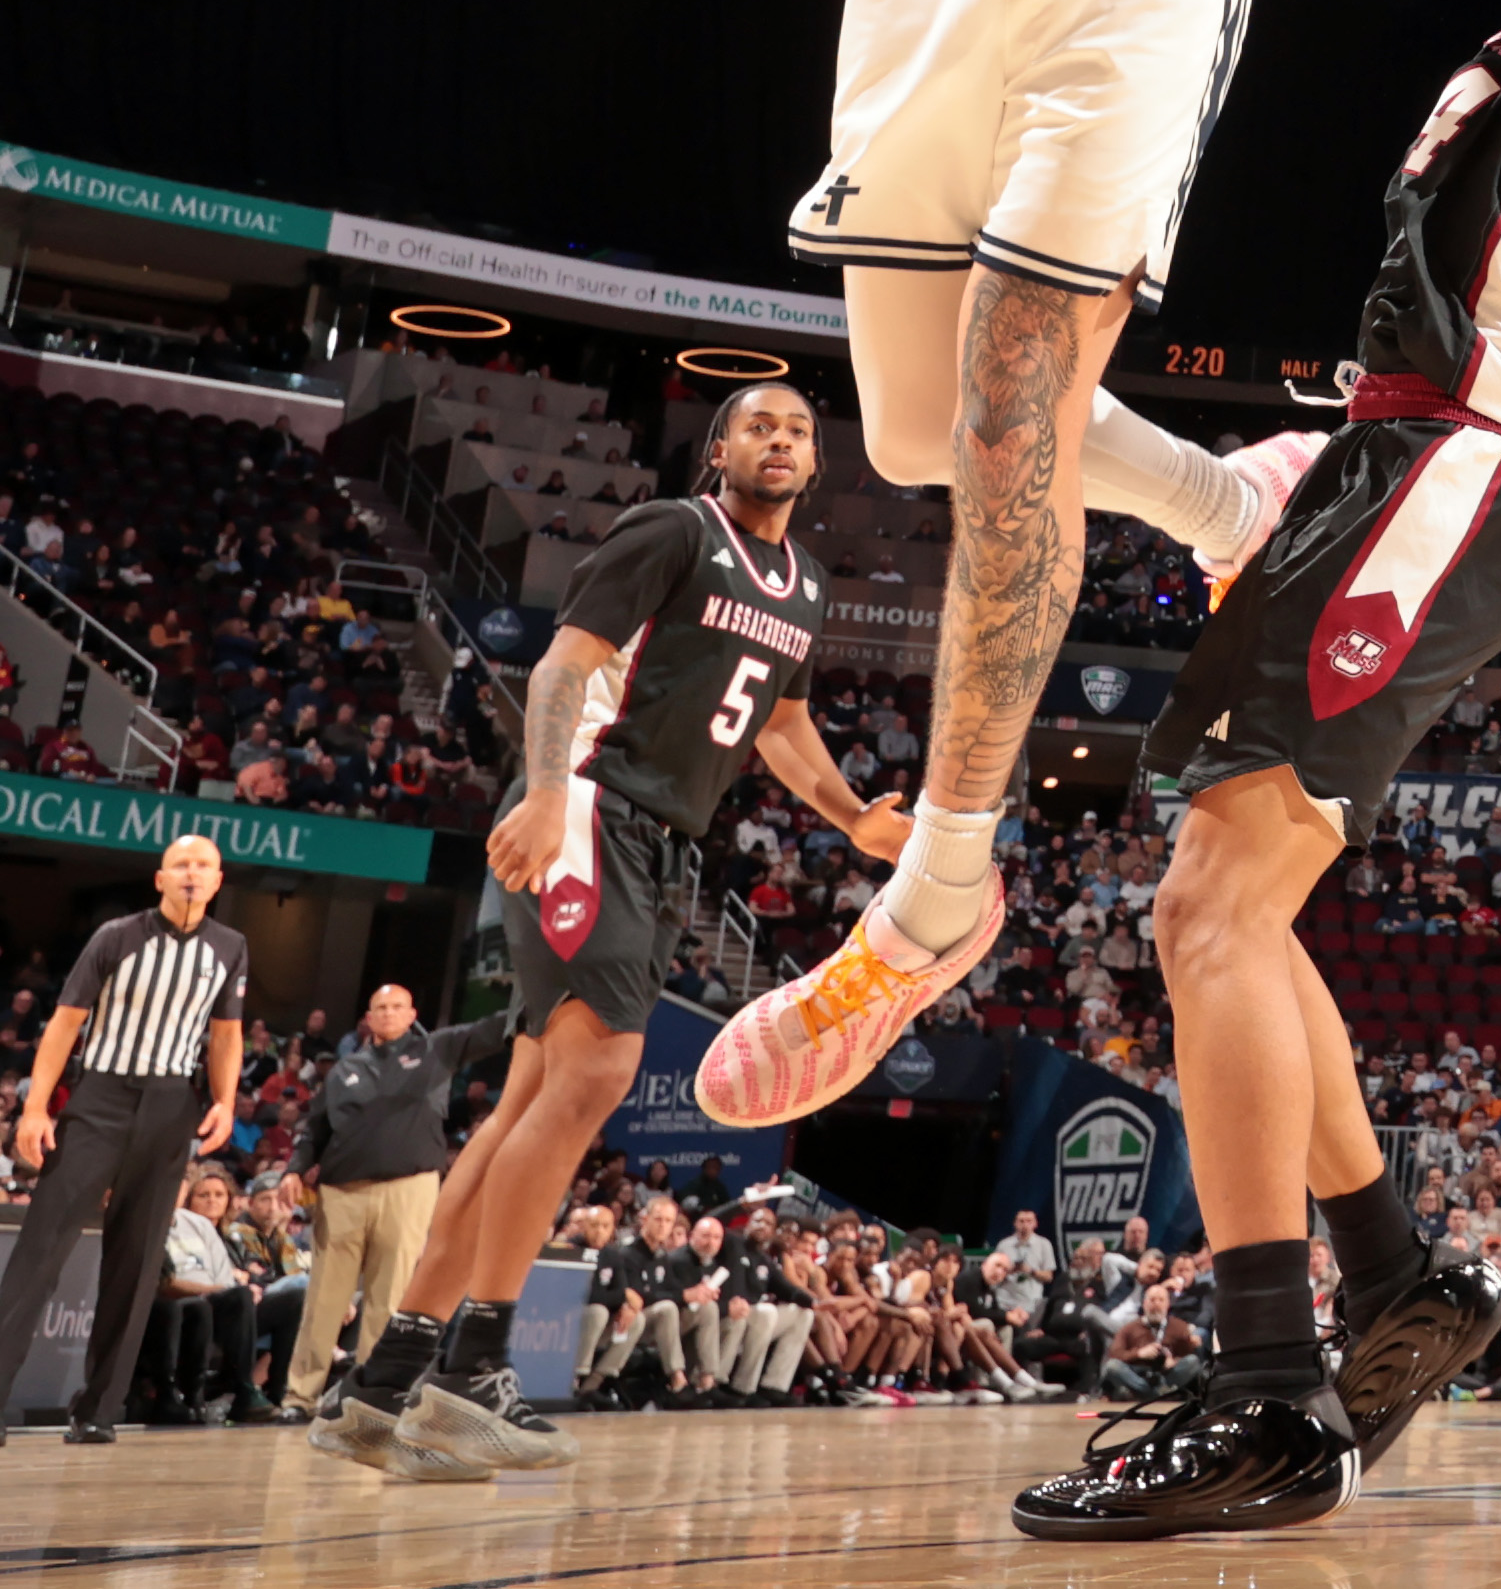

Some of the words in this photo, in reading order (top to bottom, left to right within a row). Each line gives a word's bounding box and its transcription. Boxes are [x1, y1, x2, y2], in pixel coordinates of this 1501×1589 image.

[45, 165, 165, 215] MEDICAL
[170, 193, 280, 235] MUTUAL
[350, 227, 391, 253] The
[397, 233, 474, 272] Official
[481, 253, 548, 288] Health
[556, 268, 628, 302] Insurer
[634, 285, 658, 303] of
[664, 287, 701, 308] the
[707, 291, 763, 319] MAC
[1165, 344, 1226, 377] 2:20
[1281, 359, 1322, 379] HALF
[699, 593, 813, 664] MASSACHUSETTS
[708, 653, 773, 748] 5
[118, 797, 306, 863] MUTUAL
[1062, 1171, 1140, 1224] MAC
